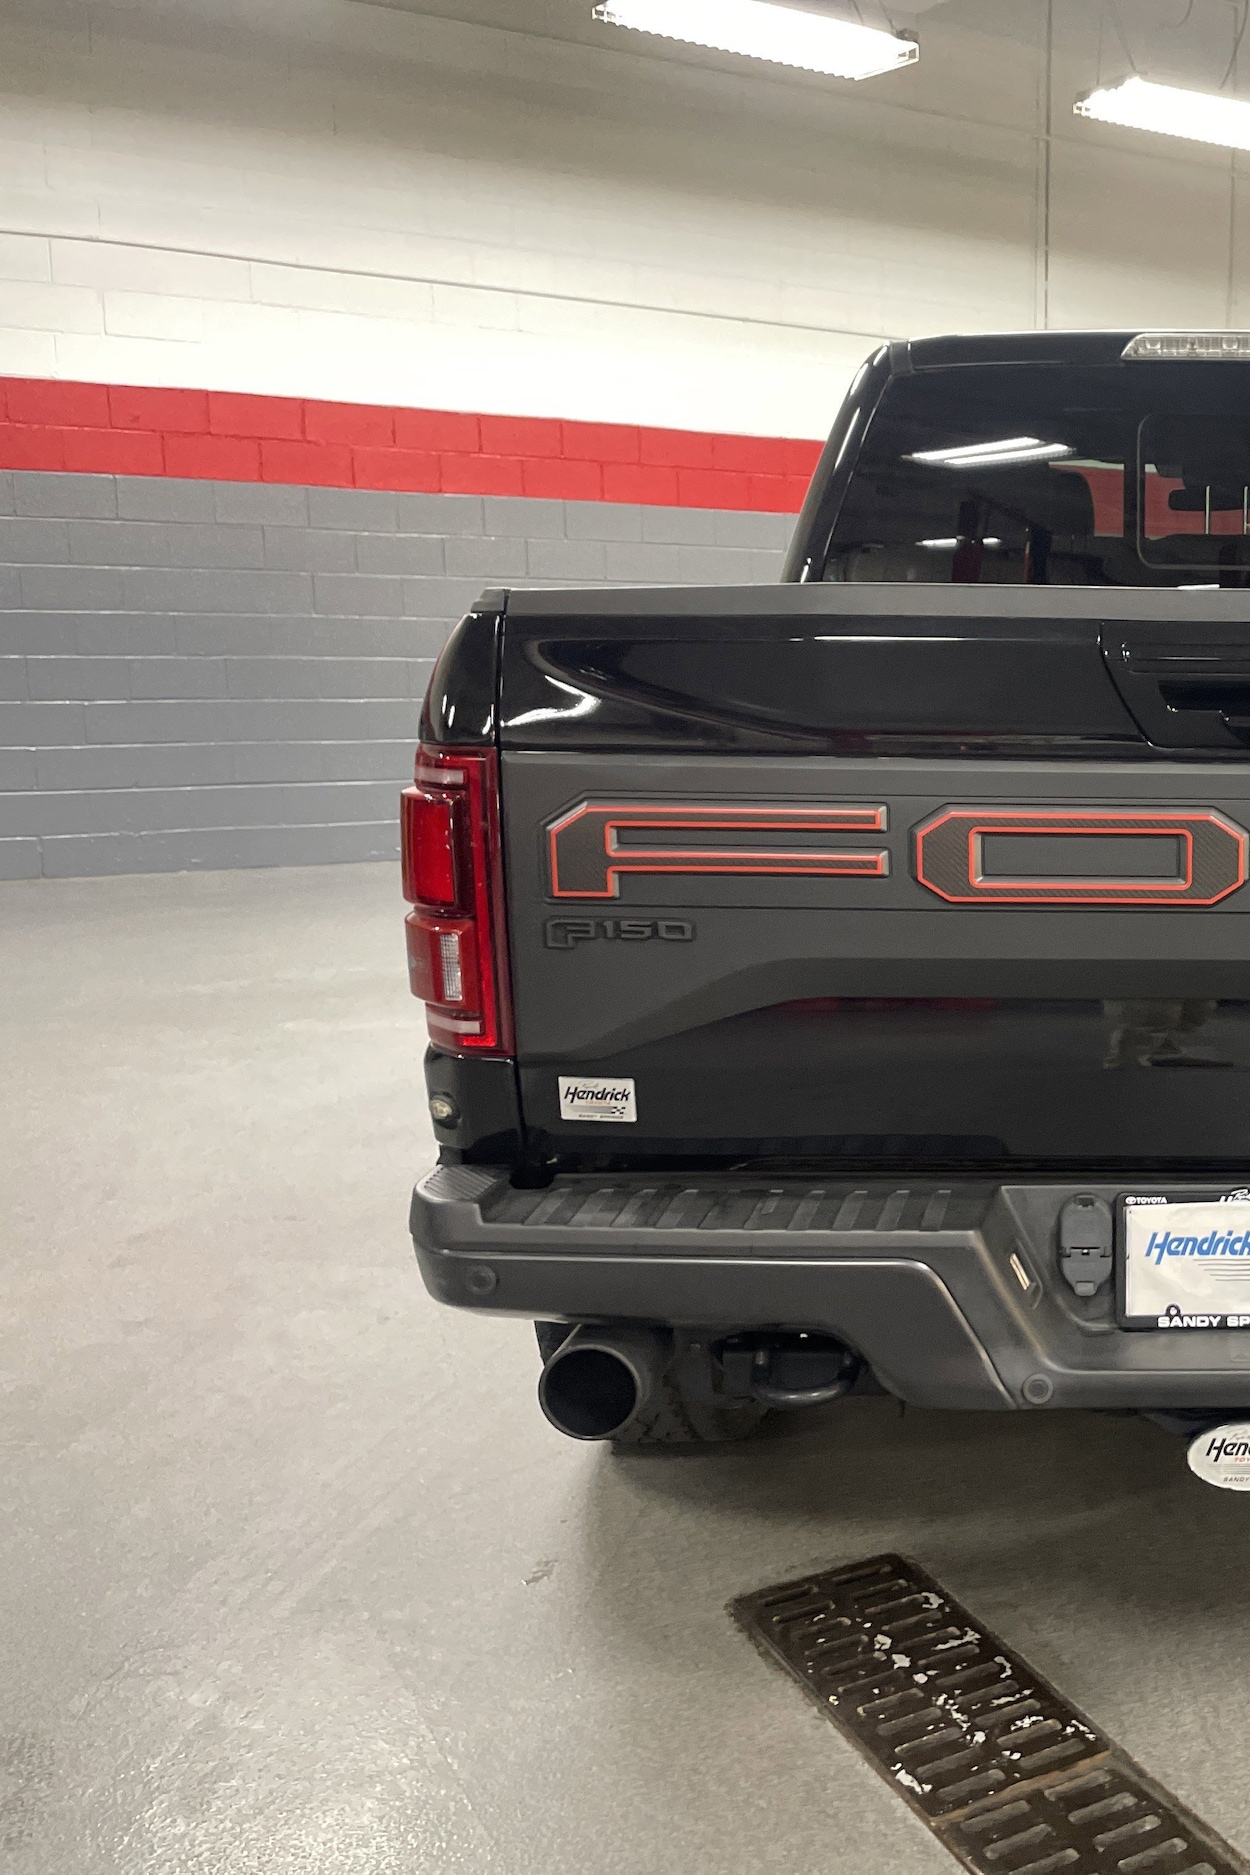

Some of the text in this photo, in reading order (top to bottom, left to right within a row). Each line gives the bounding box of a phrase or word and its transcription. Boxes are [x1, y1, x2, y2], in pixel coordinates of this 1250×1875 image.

[564, 1086, 631, 1104] Hendrick
[1136, 1196, 1168, 1205] TOYOTA
[1157, 1315, 1222, 1328] SANDY
